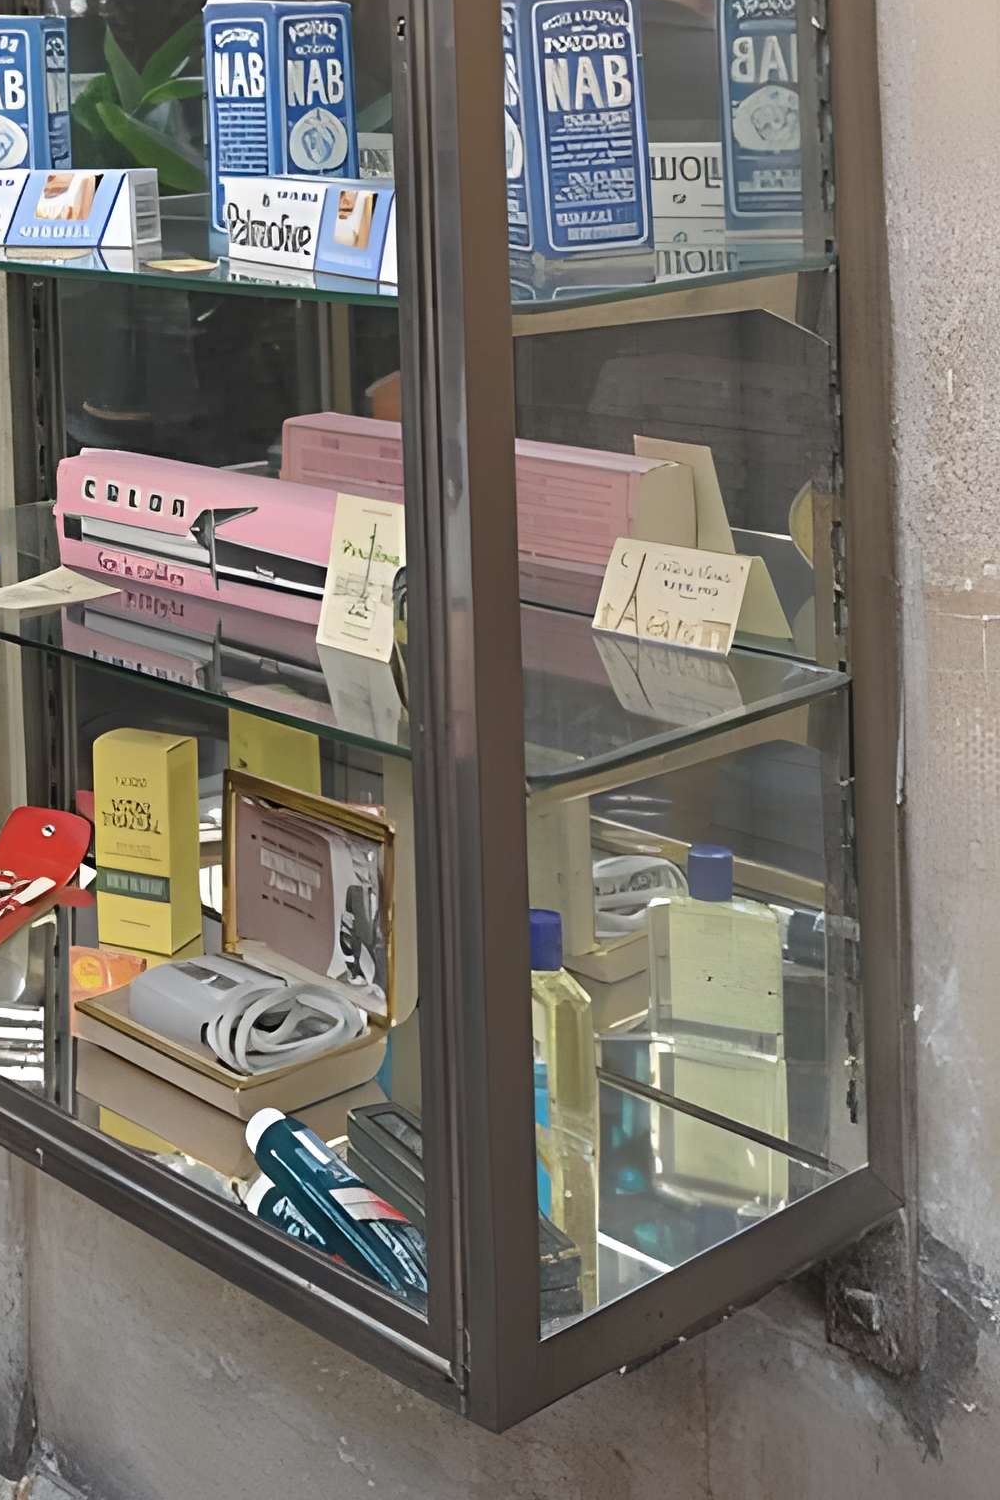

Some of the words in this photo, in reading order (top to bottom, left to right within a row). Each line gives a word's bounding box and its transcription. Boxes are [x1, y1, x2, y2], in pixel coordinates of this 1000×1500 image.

[214, 51, 266, 98] NAB
[287, 58, 345, 107] NAB
[543, 54, 632, 112] NAB
